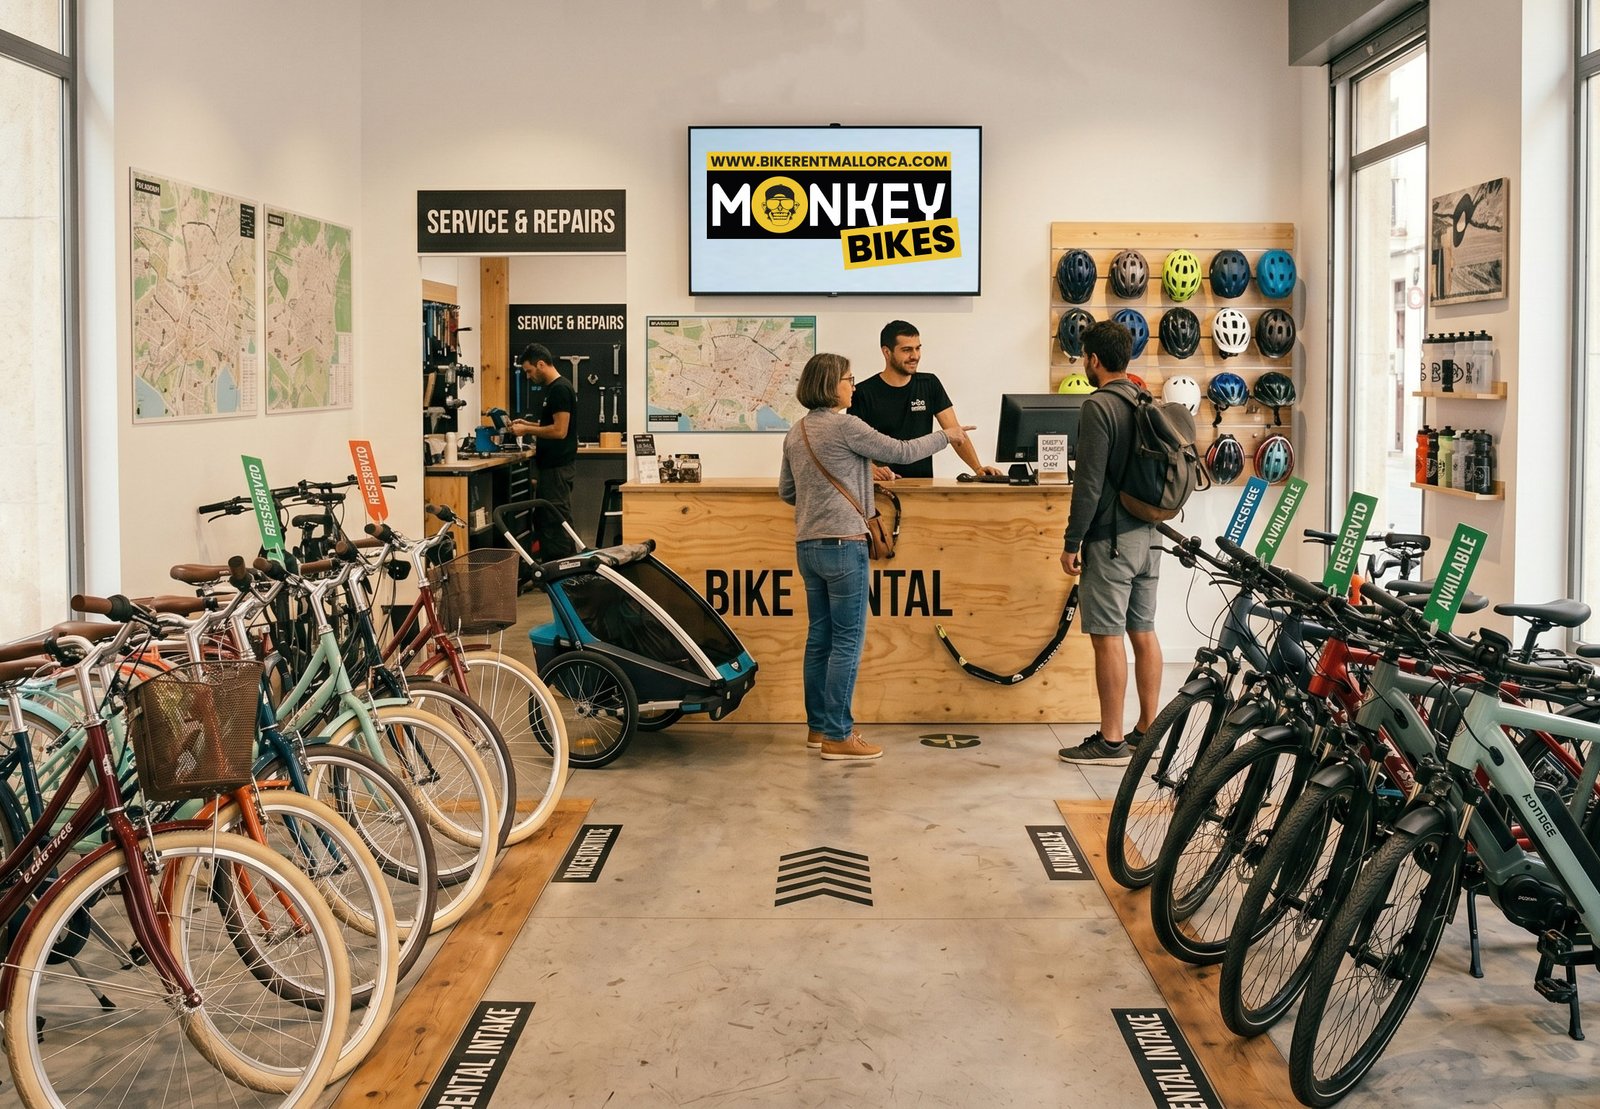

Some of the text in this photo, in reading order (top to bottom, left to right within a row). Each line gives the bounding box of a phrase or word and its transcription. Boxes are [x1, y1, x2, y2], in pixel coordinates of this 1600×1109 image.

[710, 155, 948, 168] WWW.BIKERENTMALLORCA.COM
[427, 208, 616, 234] SERVICE & REPAIRS
[848, 224, 956, 264] BIKES
[517, 315, 624, 331] SERVICE & REPAIRS
[1264, 482, 1302, 549] AVAILABLE
[706, 569, 953, 617] BIKE NTAL
[1435, 532, 1478, 612] AVAILABLE
[465, 1007, 522, 1055] INTAKE
[1125, 1013, 1209, 1109] ENTAL INTAKE
